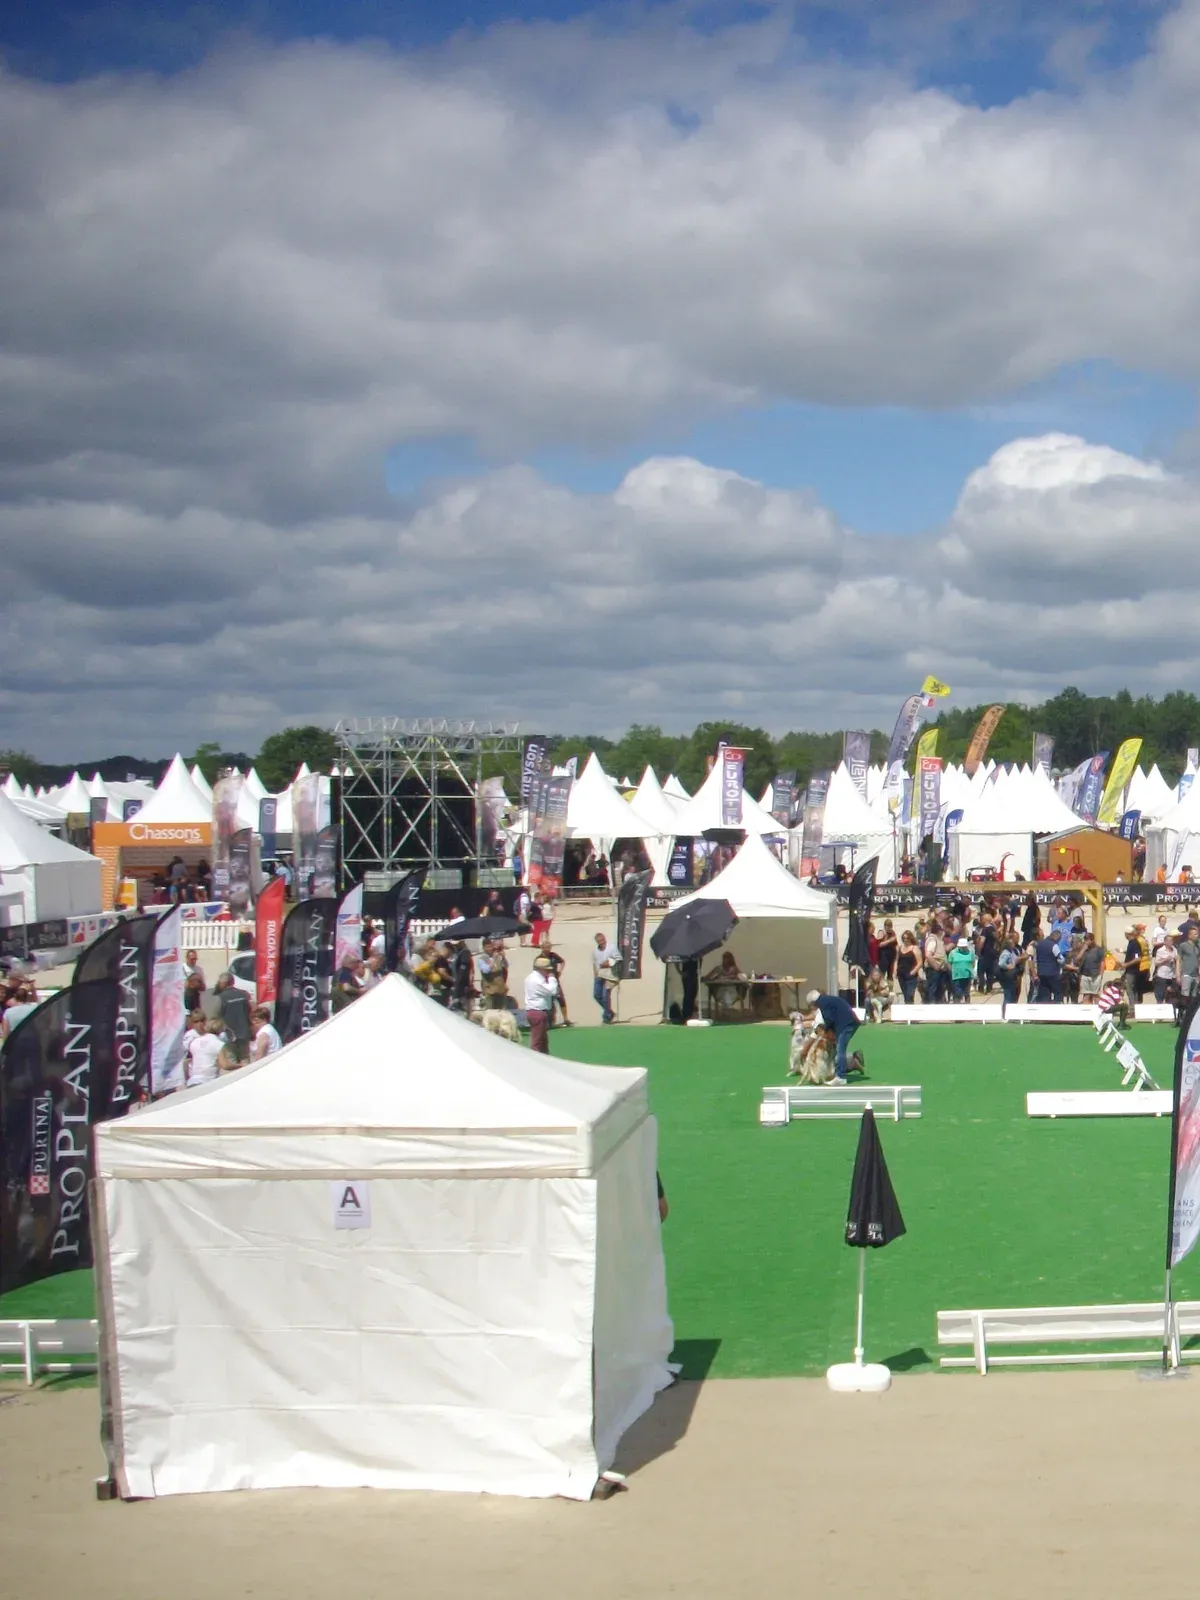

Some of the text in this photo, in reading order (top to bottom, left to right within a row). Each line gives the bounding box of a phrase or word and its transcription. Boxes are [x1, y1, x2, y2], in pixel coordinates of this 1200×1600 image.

[130, 823, 201, 840] Chassons
[873, 894, 924, 903] ROPLAN
[33, 1100, 50, 1173] PURINA
[340, 1186, 361, 1209] A
